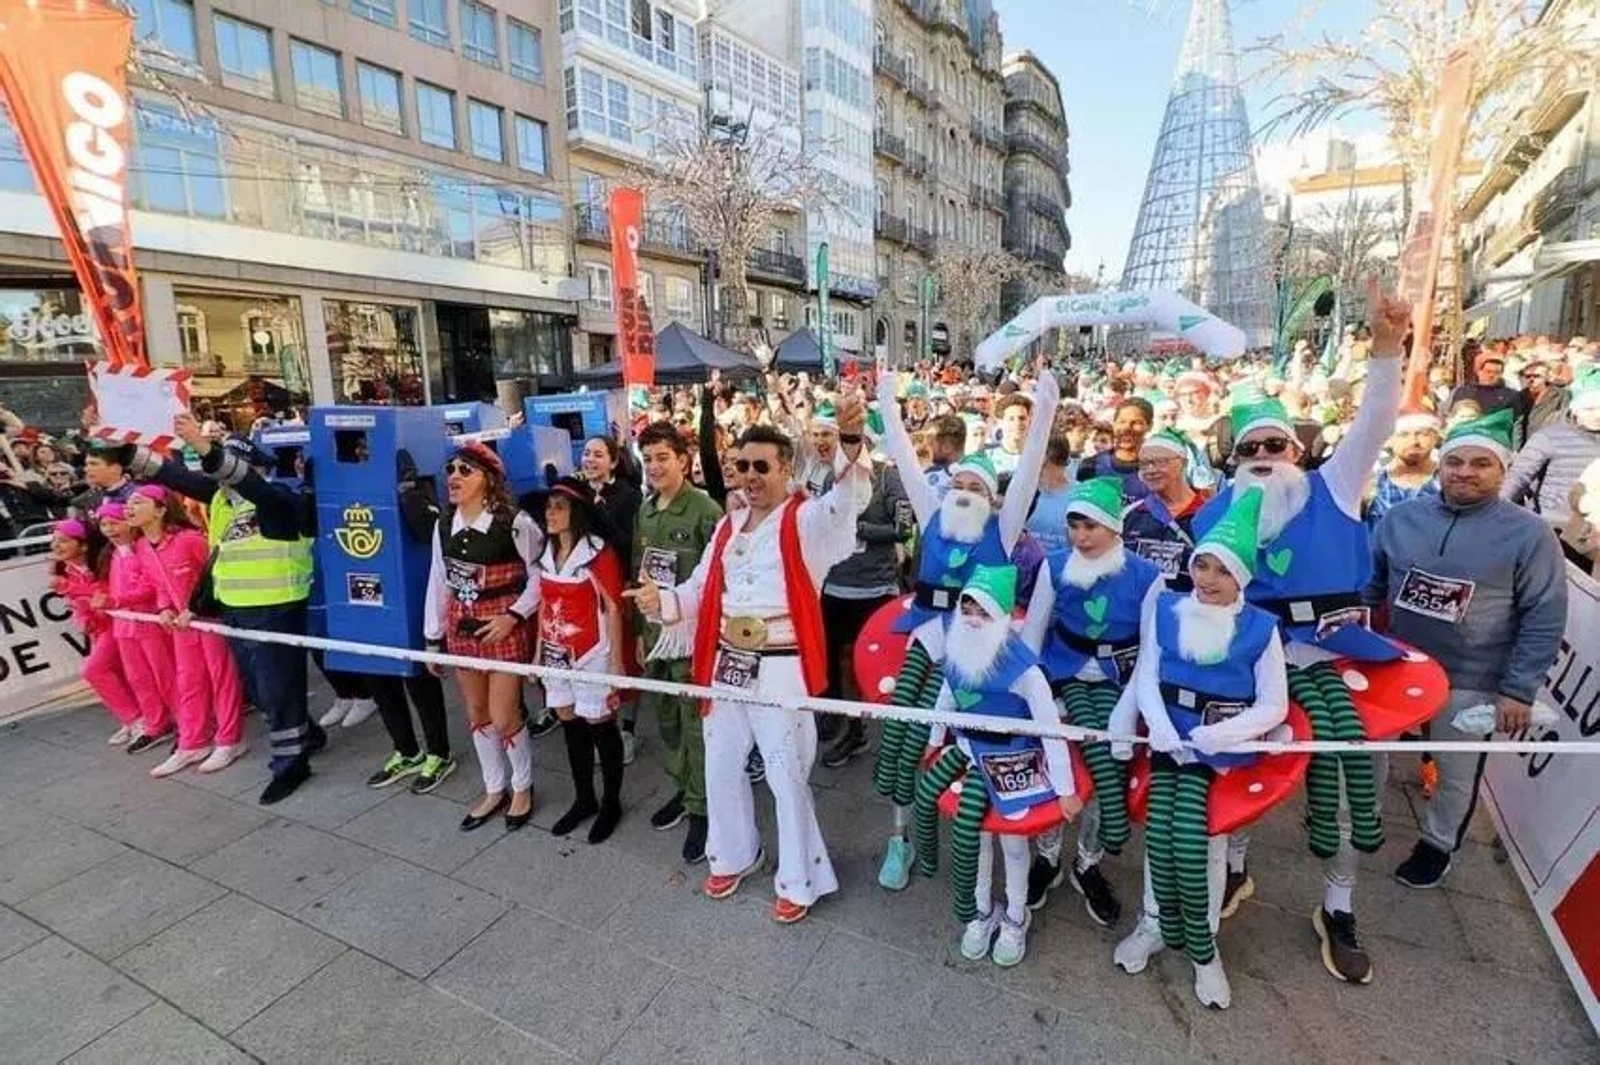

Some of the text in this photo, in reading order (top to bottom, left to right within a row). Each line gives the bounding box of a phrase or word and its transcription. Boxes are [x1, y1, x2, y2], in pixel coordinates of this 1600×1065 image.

[1407, 590, 1459, 613] 2554
[723, 670, 752, 688] 487
[997, 769, 1034, 791] 1697
